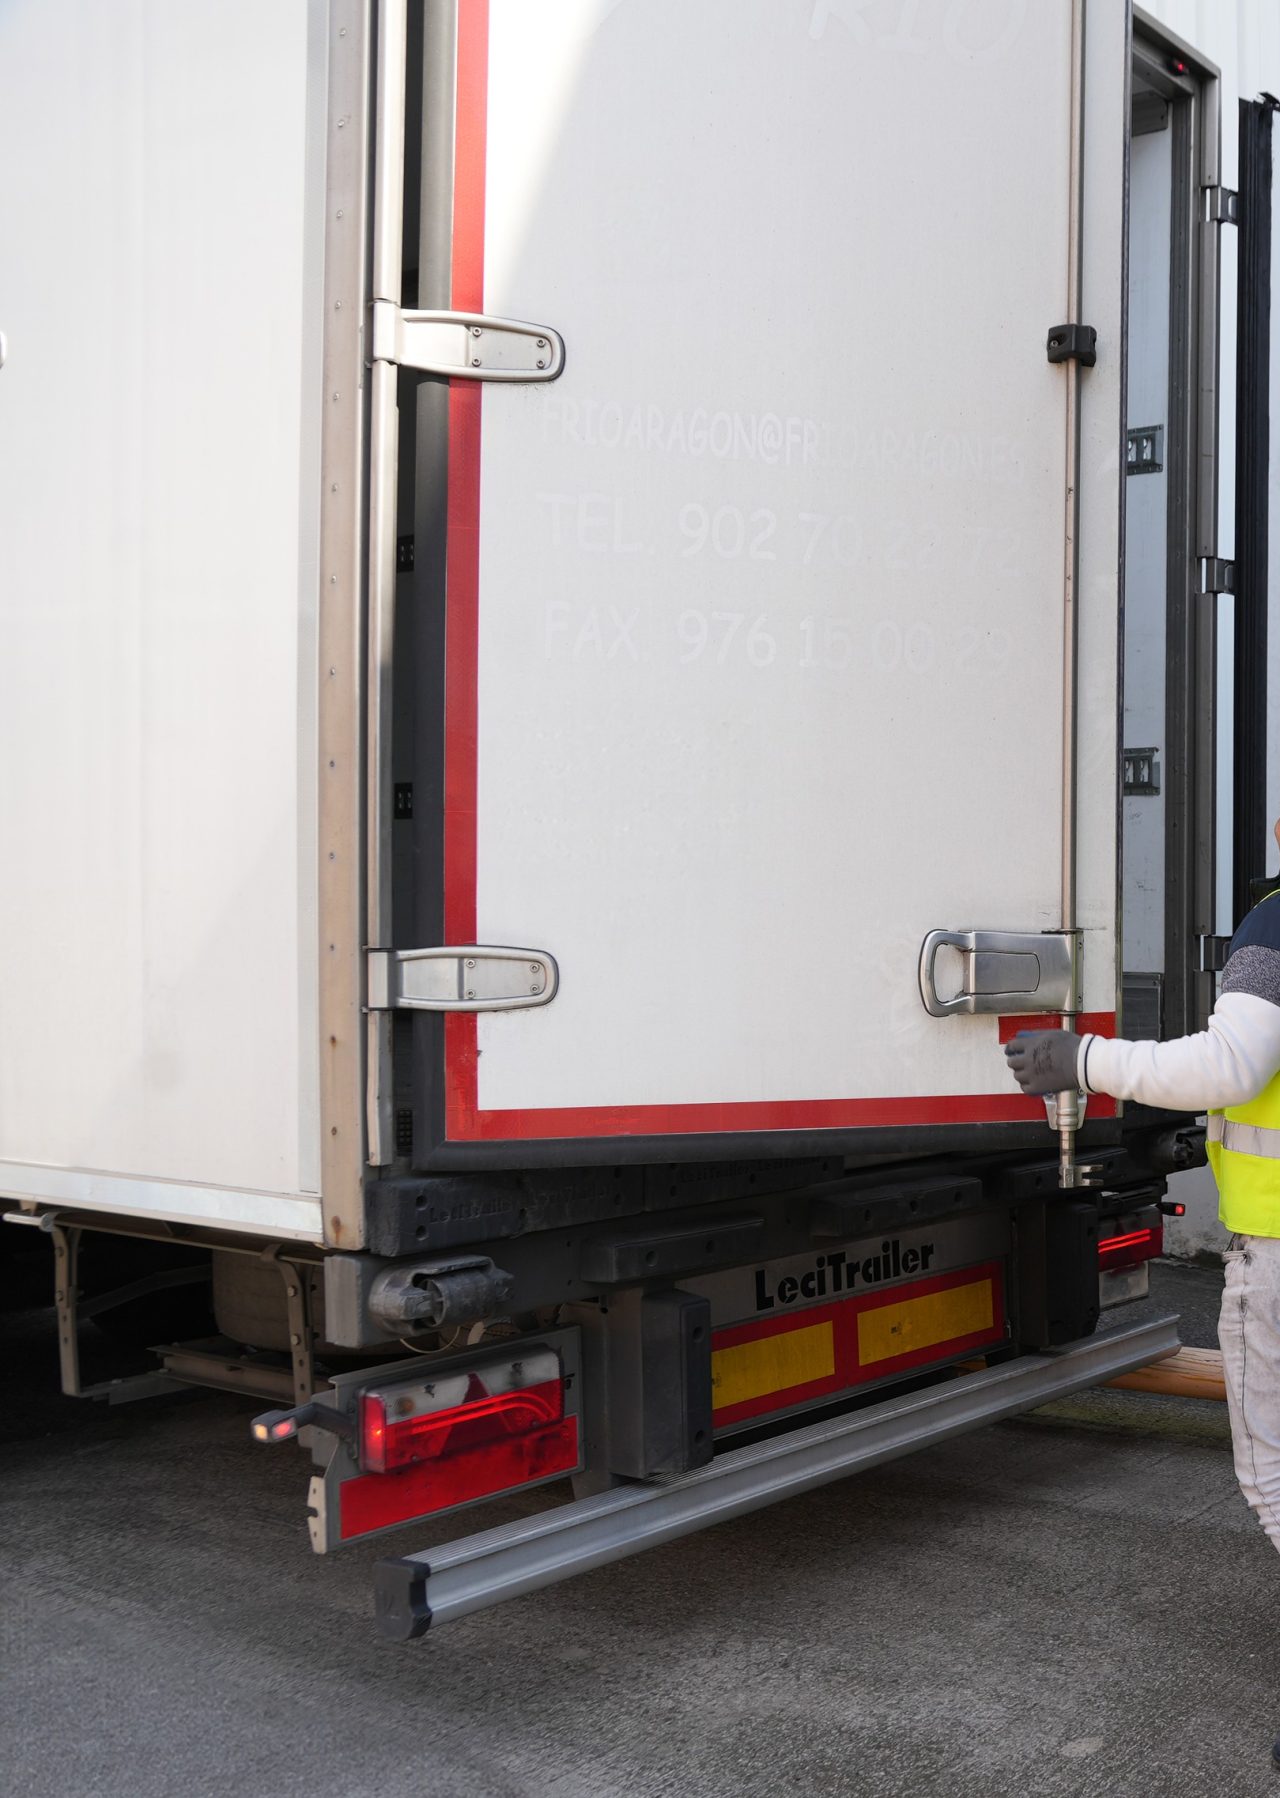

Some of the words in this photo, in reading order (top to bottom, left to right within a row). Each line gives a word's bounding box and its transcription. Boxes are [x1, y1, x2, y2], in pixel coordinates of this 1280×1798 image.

[535, 491, 655, 556] TEL.
[677, 502, 778, 562] 902
[797, 511, 863, 567] 70
[676, 608, 778, 669] 976
[797, 614, 853, 670] 15
[870, 620, 936, 675] 00
[755, 1239, 935, 1312] LeciTrailer
